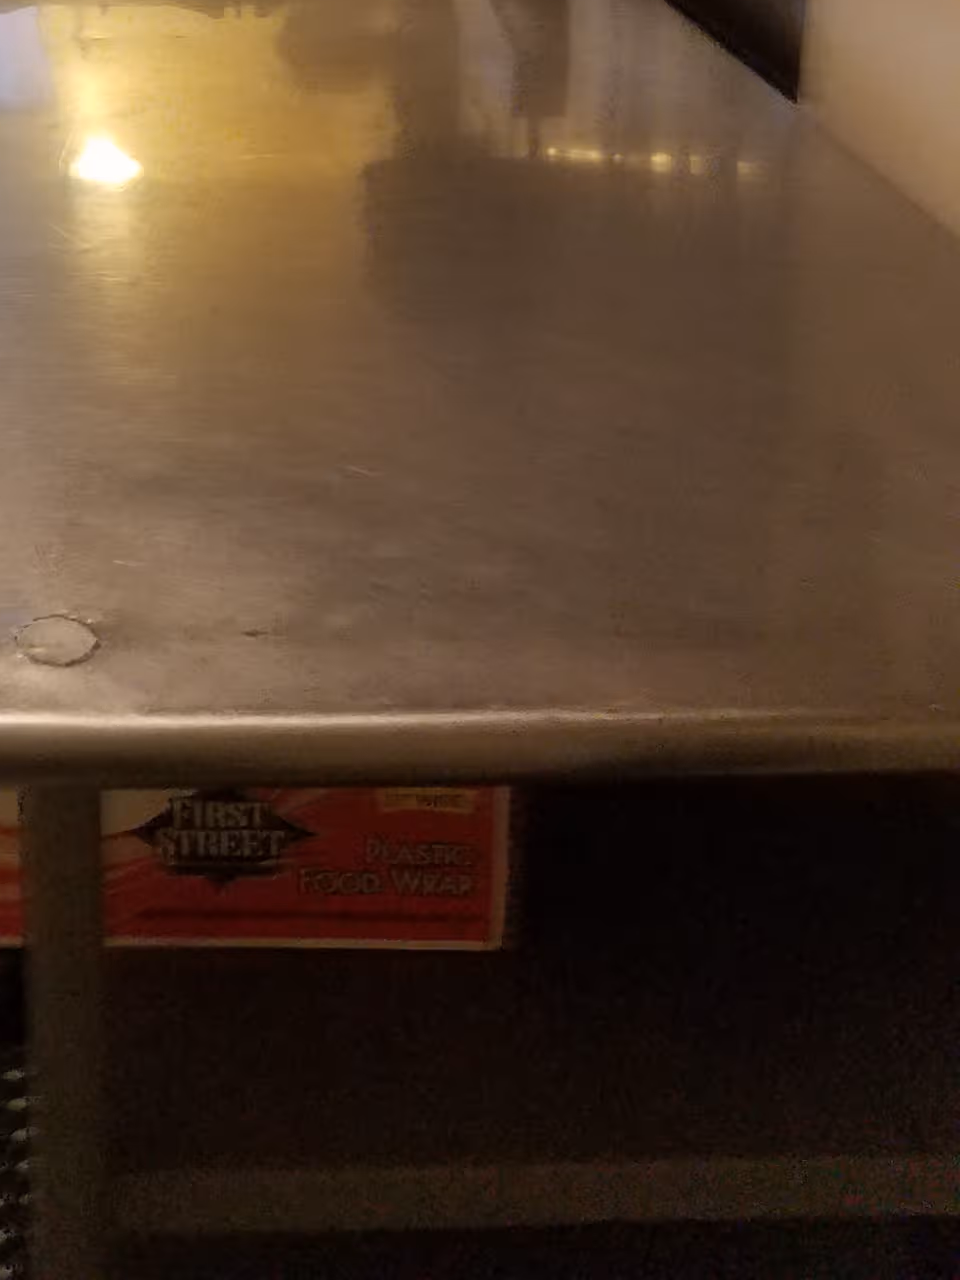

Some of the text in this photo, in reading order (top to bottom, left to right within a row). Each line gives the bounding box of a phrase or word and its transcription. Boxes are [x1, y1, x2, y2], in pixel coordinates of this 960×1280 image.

[171, 799, 271, 829] FIRST
[158, 828, 287, 860] STREET
[366, 837, 474, 865] PLASTIC
[300, 867, 475, 896] FOOD WRAP
